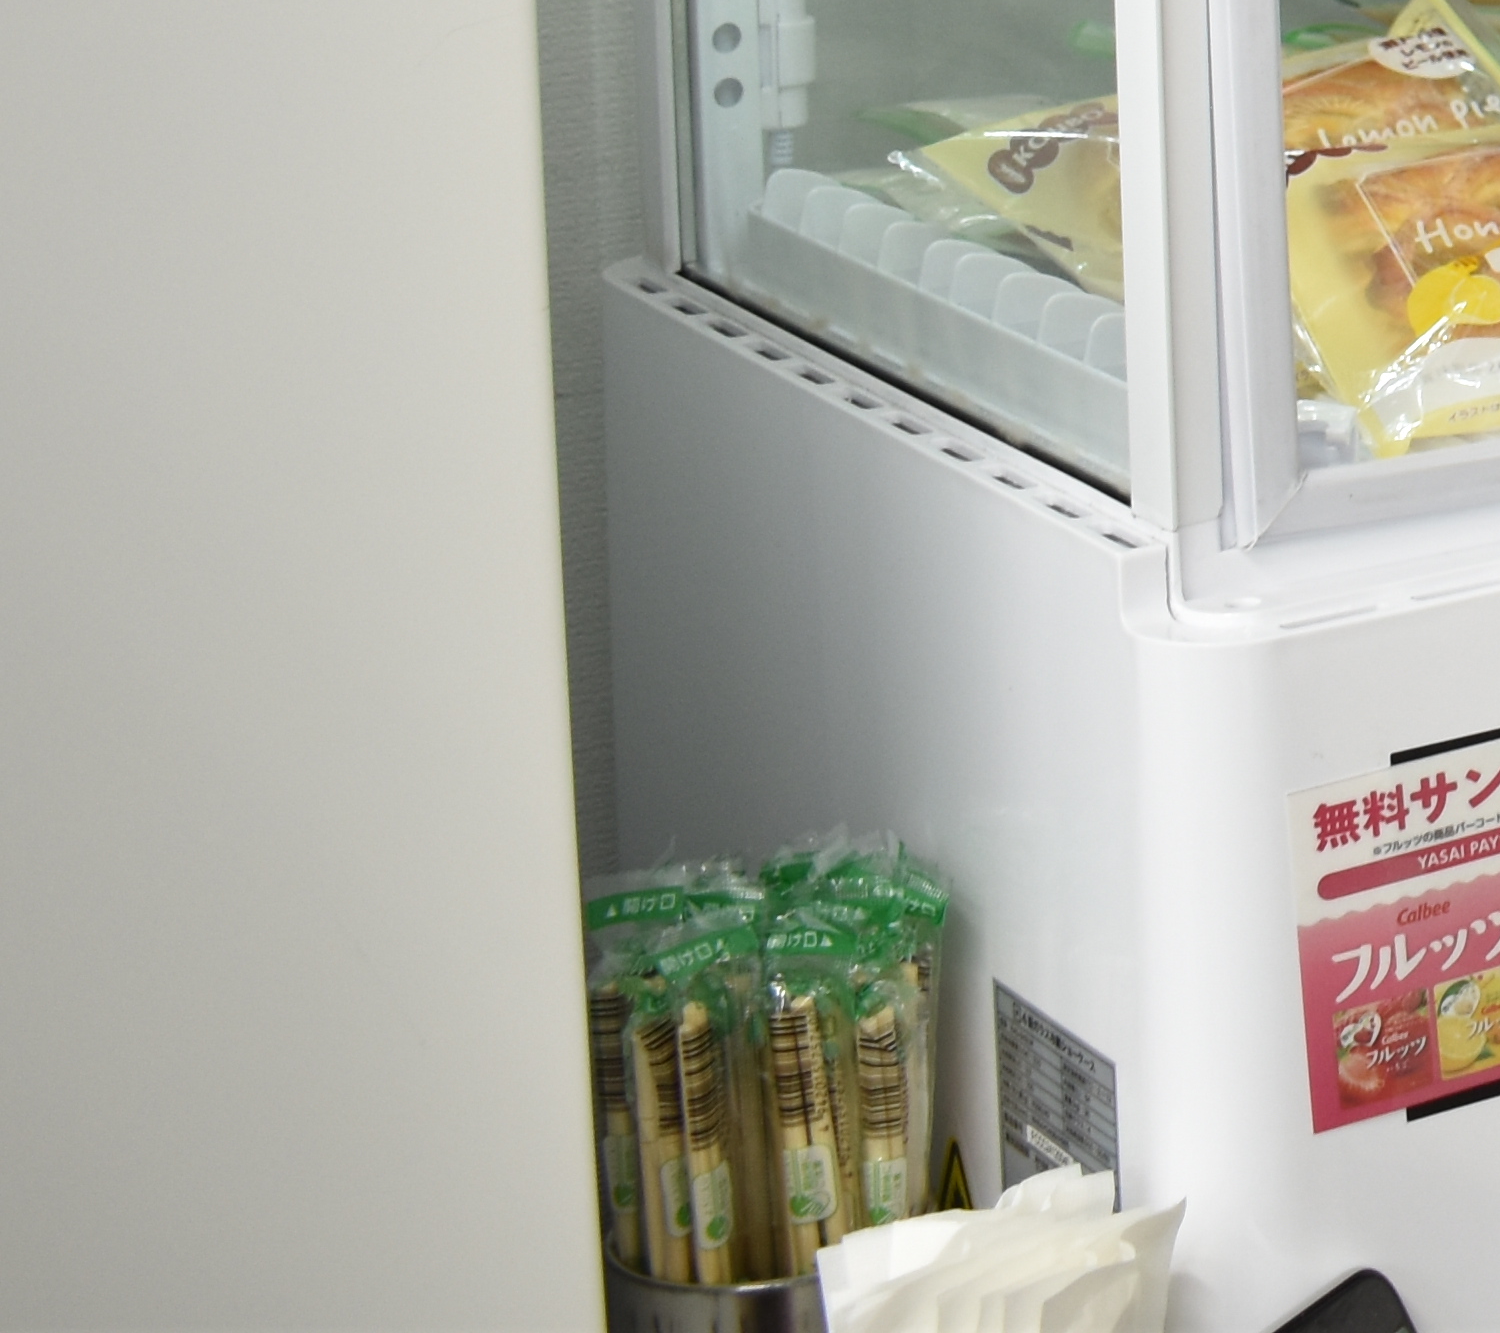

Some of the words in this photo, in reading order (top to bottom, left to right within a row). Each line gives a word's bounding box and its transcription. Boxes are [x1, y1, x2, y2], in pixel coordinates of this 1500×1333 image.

[1417, 844, 1466, 870] YASAI
[1397, 898, 1452, 926] Calbee
[1365, 1035, 1427, 1068] フルッツ
